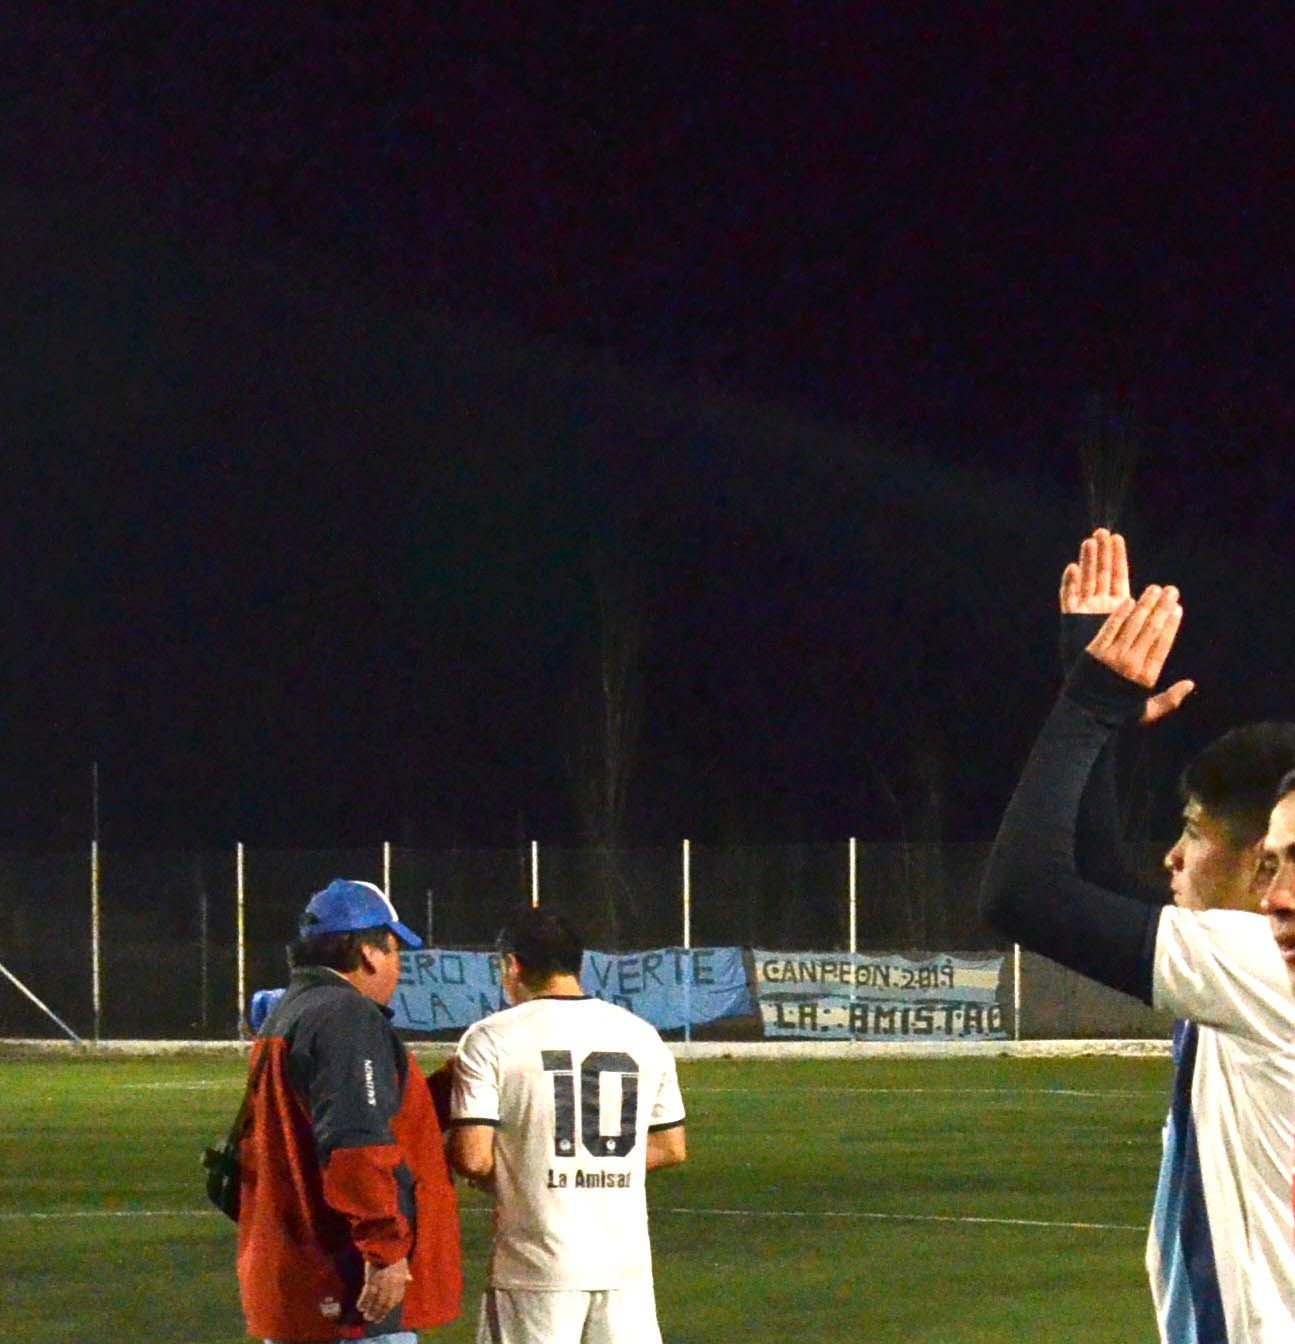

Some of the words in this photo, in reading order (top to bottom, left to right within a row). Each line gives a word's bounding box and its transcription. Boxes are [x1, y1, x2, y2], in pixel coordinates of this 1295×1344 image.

[590, 950, 716, 994] VERTE
[774, 1002, 818, 1032] LA
[541, 1050, 639, 1157] 10
[547, 1169, 567, 1189] La
